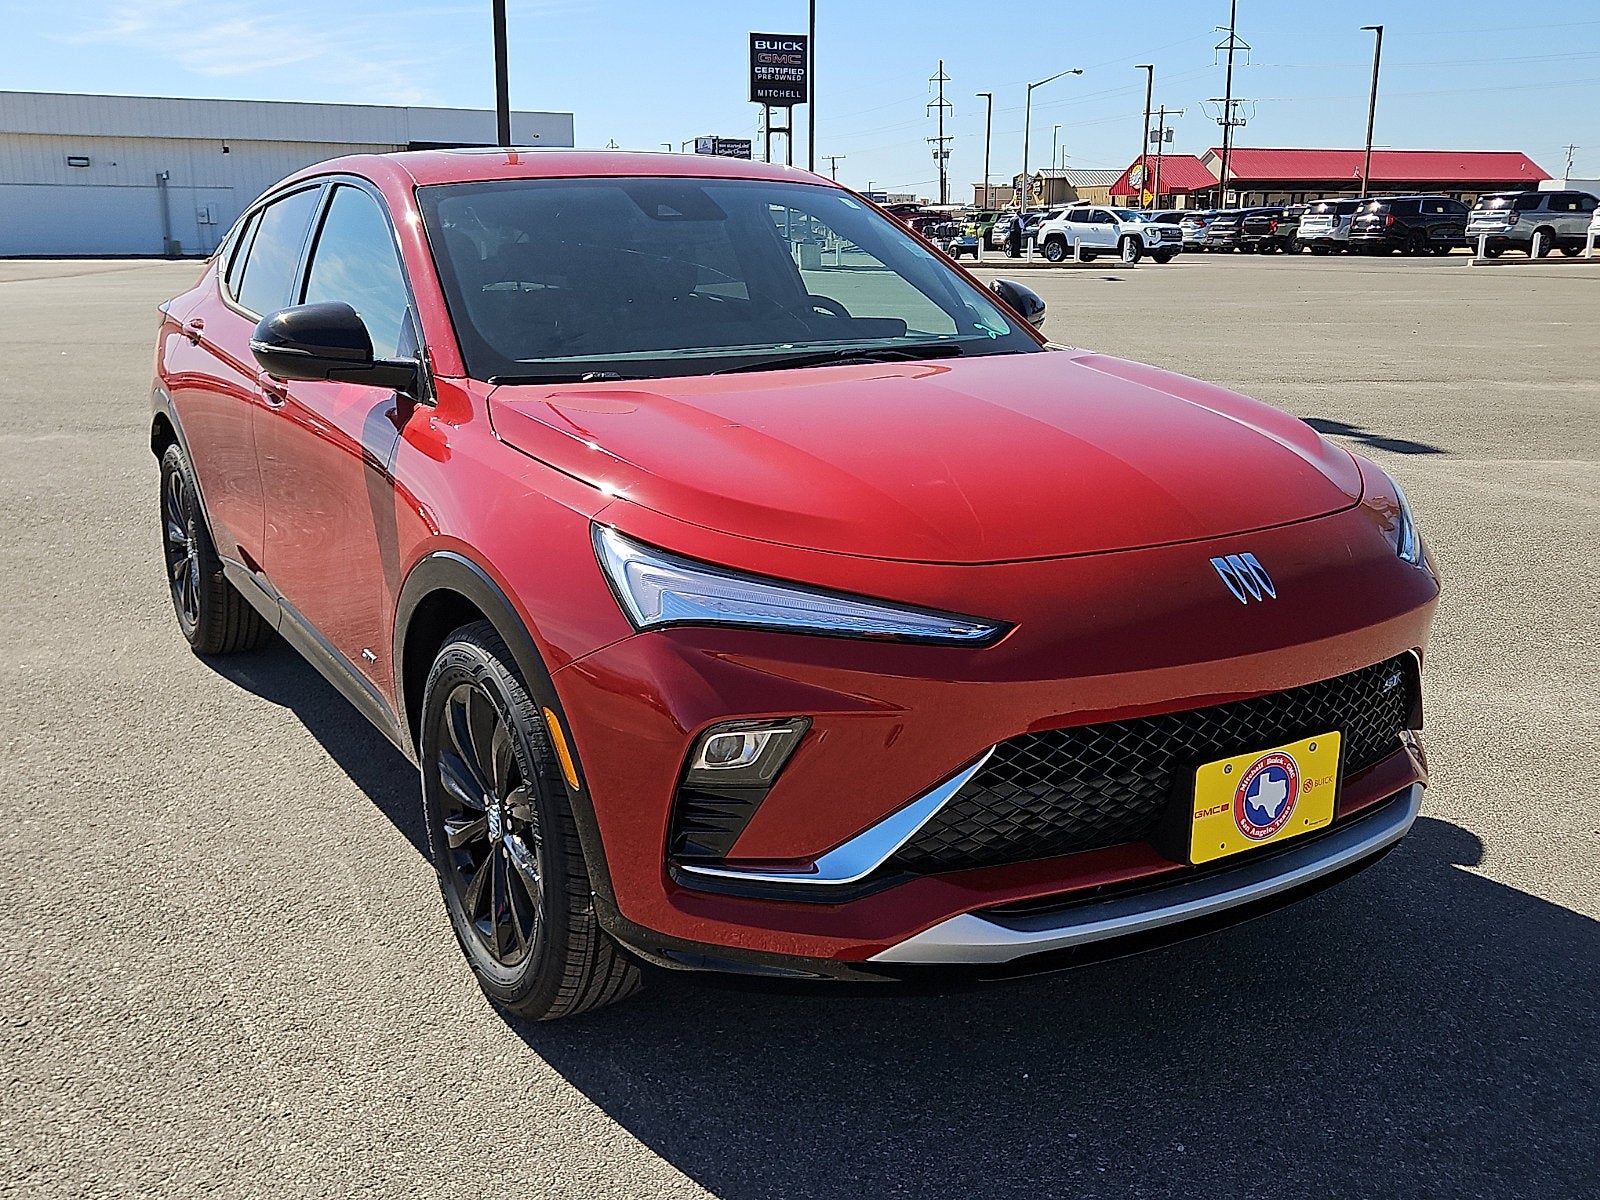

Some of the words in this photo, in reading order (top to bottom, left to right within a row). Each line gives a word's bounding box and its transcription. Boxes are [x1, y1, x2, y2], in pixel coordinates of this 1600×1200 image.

[755, 40, 804, 51] BUICK
[757, 53, 802, 64] GMC
[754, 66, 805, 75] CERTIFIED
[757, 89, 801, 98] MITCHELL
[1239, 761, 1264, 792] Mitchell
[1266, 757, 1284, 766] Buick
[1286, 763, 1296, 779] GMC
[1314, 776, 1333, 788] BUICK
[1194, 805, 1220, 819] GMC
[1239, 818, 1250, 832] San
[1274, 805, 1291, 831] Texas
